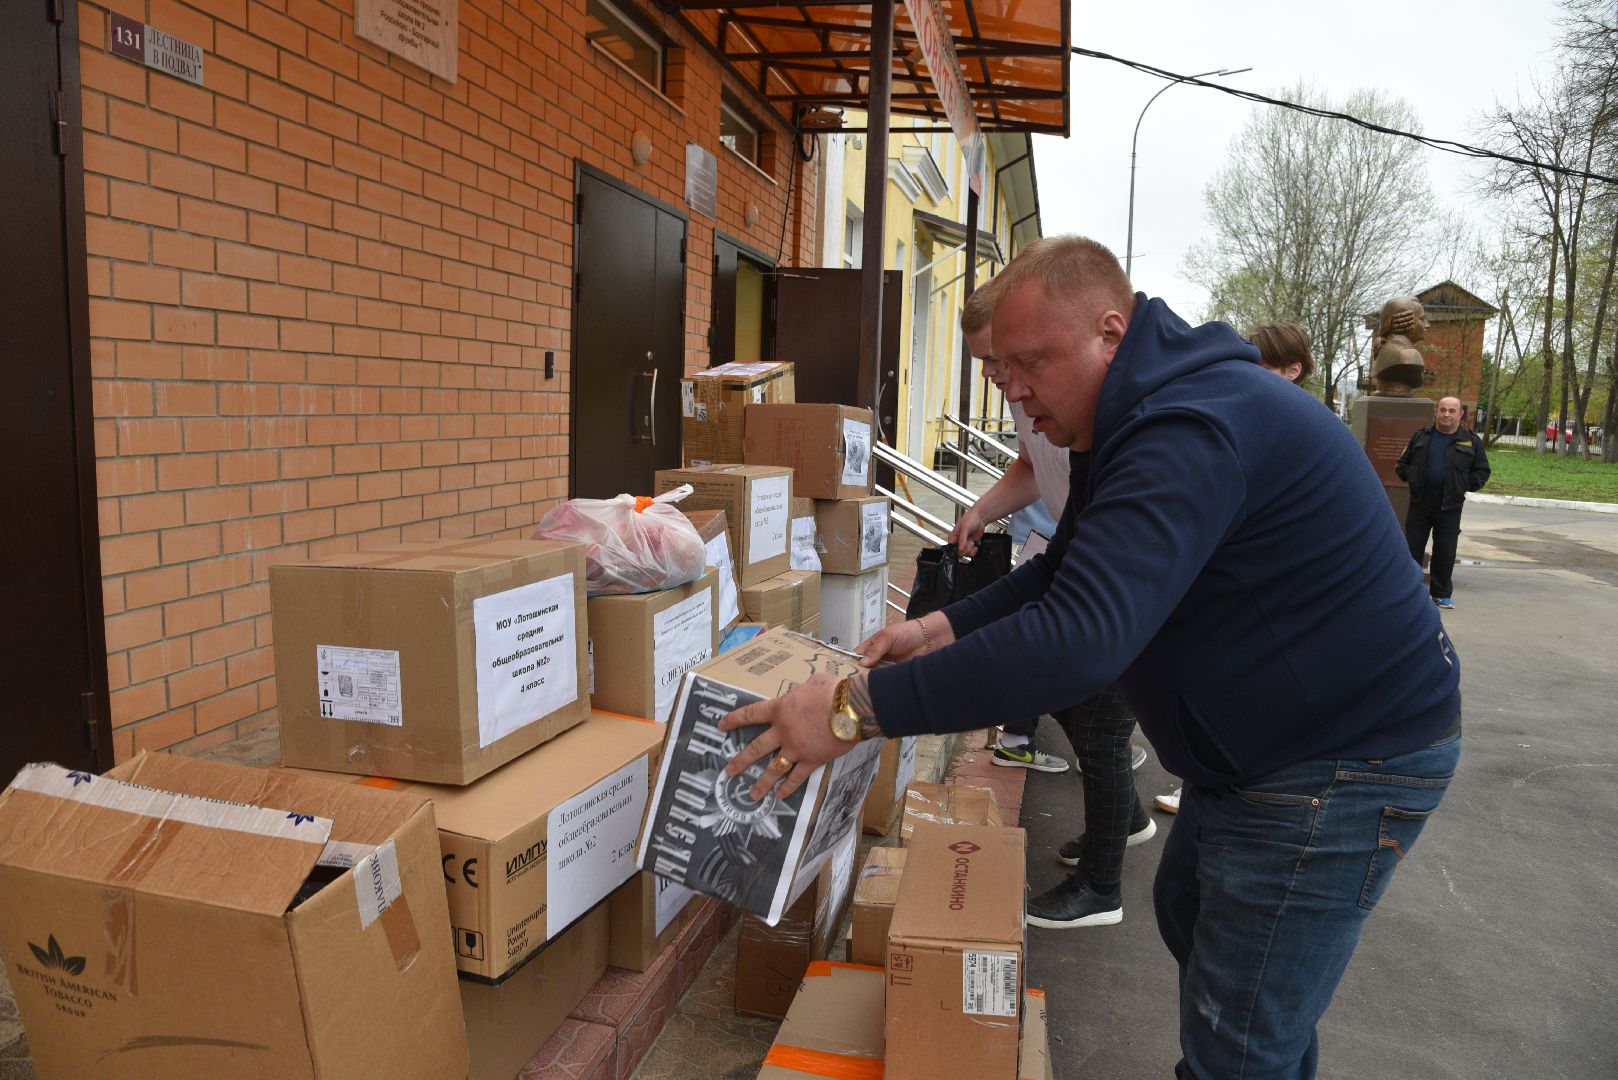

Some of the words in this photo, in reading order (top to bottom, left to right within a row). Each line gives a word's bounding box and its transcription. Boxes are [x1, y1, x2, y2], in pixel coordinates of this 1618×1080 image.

[115, 26, 141, 50] 131
[149, 29, 200, 63] ЛЕСТНИЦА
[153, 49, 159, 65] В
[161, 52, 197, 80] ПОДВАЛ
[496, 617, 512, 631] МОУ
[514, 603, 559, 625] «Лотошинская
[517, 626, 544, 642] средняя
[492, 634, 564, 668] общеобразовательная
[512, 664, 535, 678] школа
[526, 677, 545, 691] класс
[651, 769, 716, 885] ПОБЕДЫ
[948, 857, 970, 911] ОСТАНКИНО
[507, 928, 527, 947] Power
[507, 938, 529, 959] Supply
[16, 963, 56, 985] BRITISH
[60, 977, 117, 1002] AMERICAN
[44, 984, 93, 1009] TOBACCO
[55, 1003, 86, 1018] GROUP
